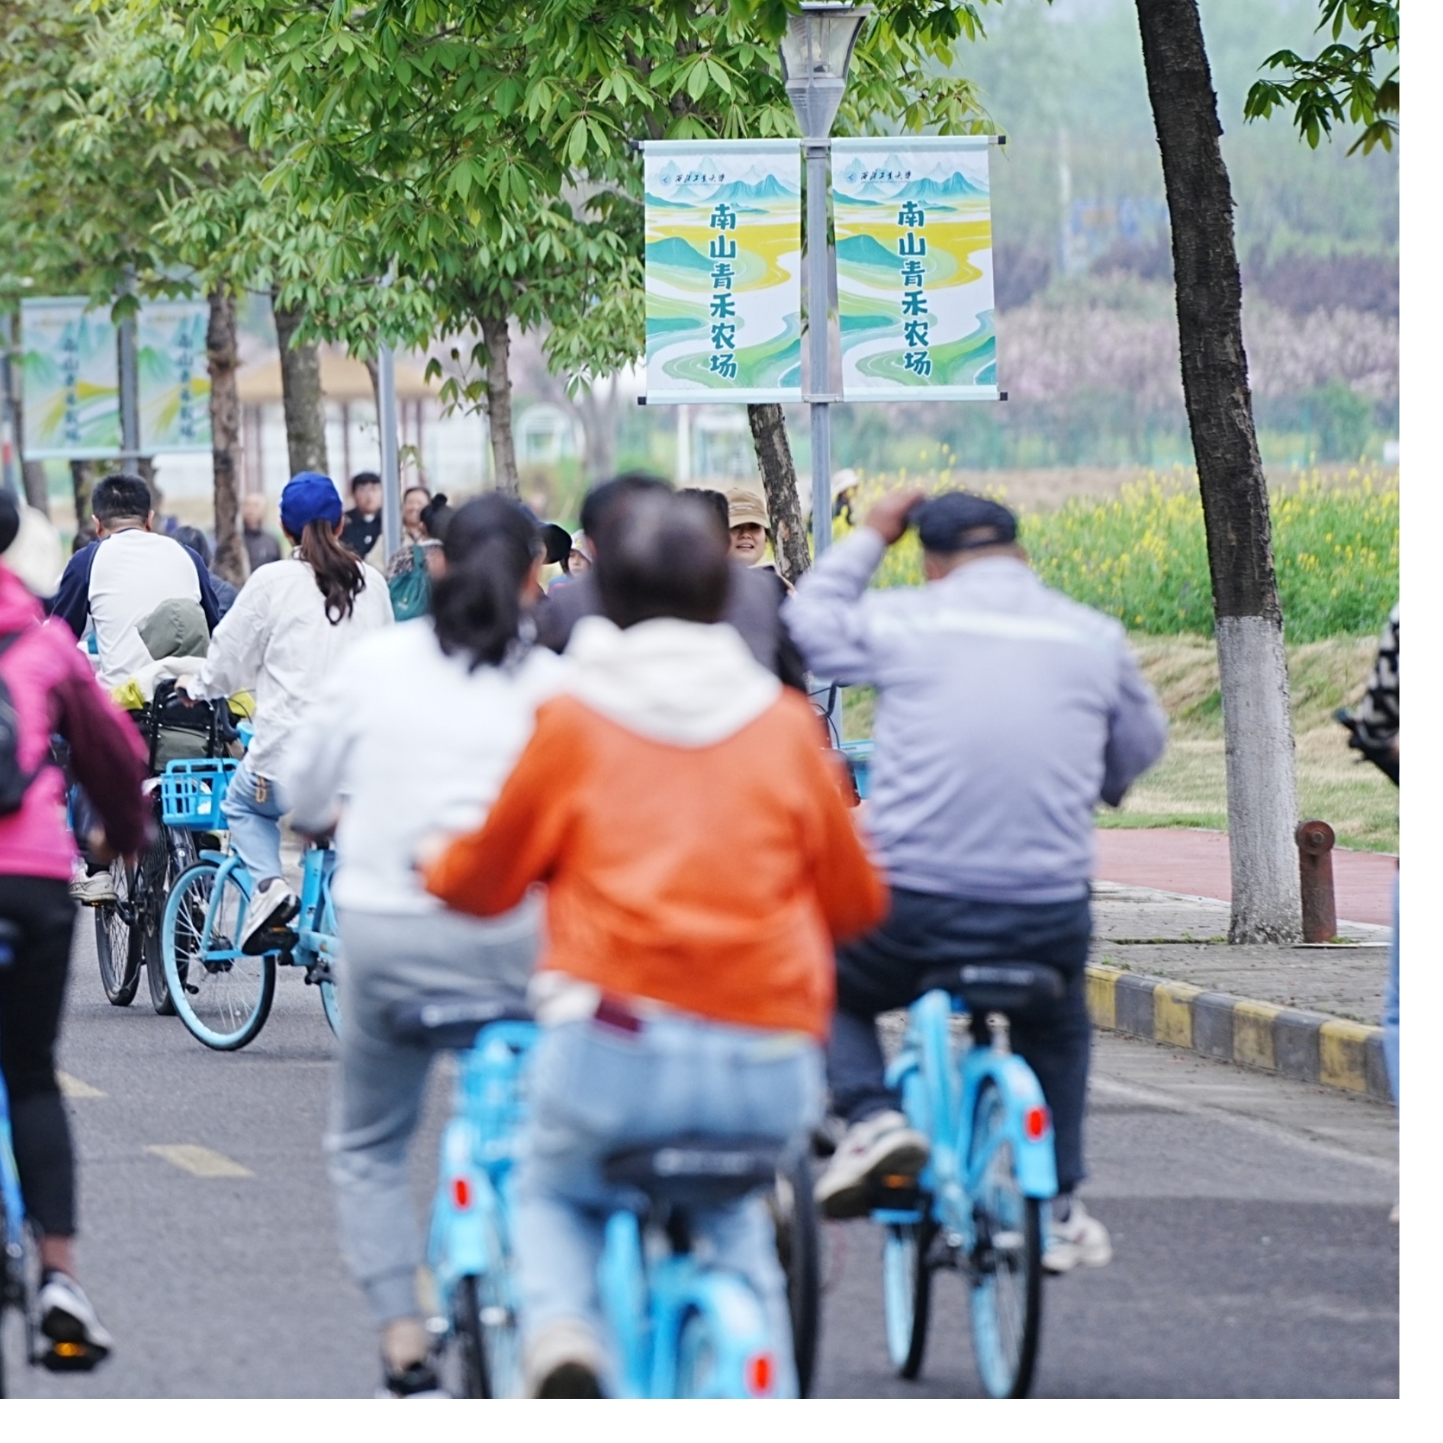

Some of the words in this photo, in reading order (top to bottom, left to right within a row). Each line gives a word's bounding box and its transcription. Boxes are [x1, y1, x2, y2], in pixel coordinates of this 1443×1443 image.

[709, 203, 737, 379] 南山青禾农场
[897, 201, 932, 377] 南山青禾农场
